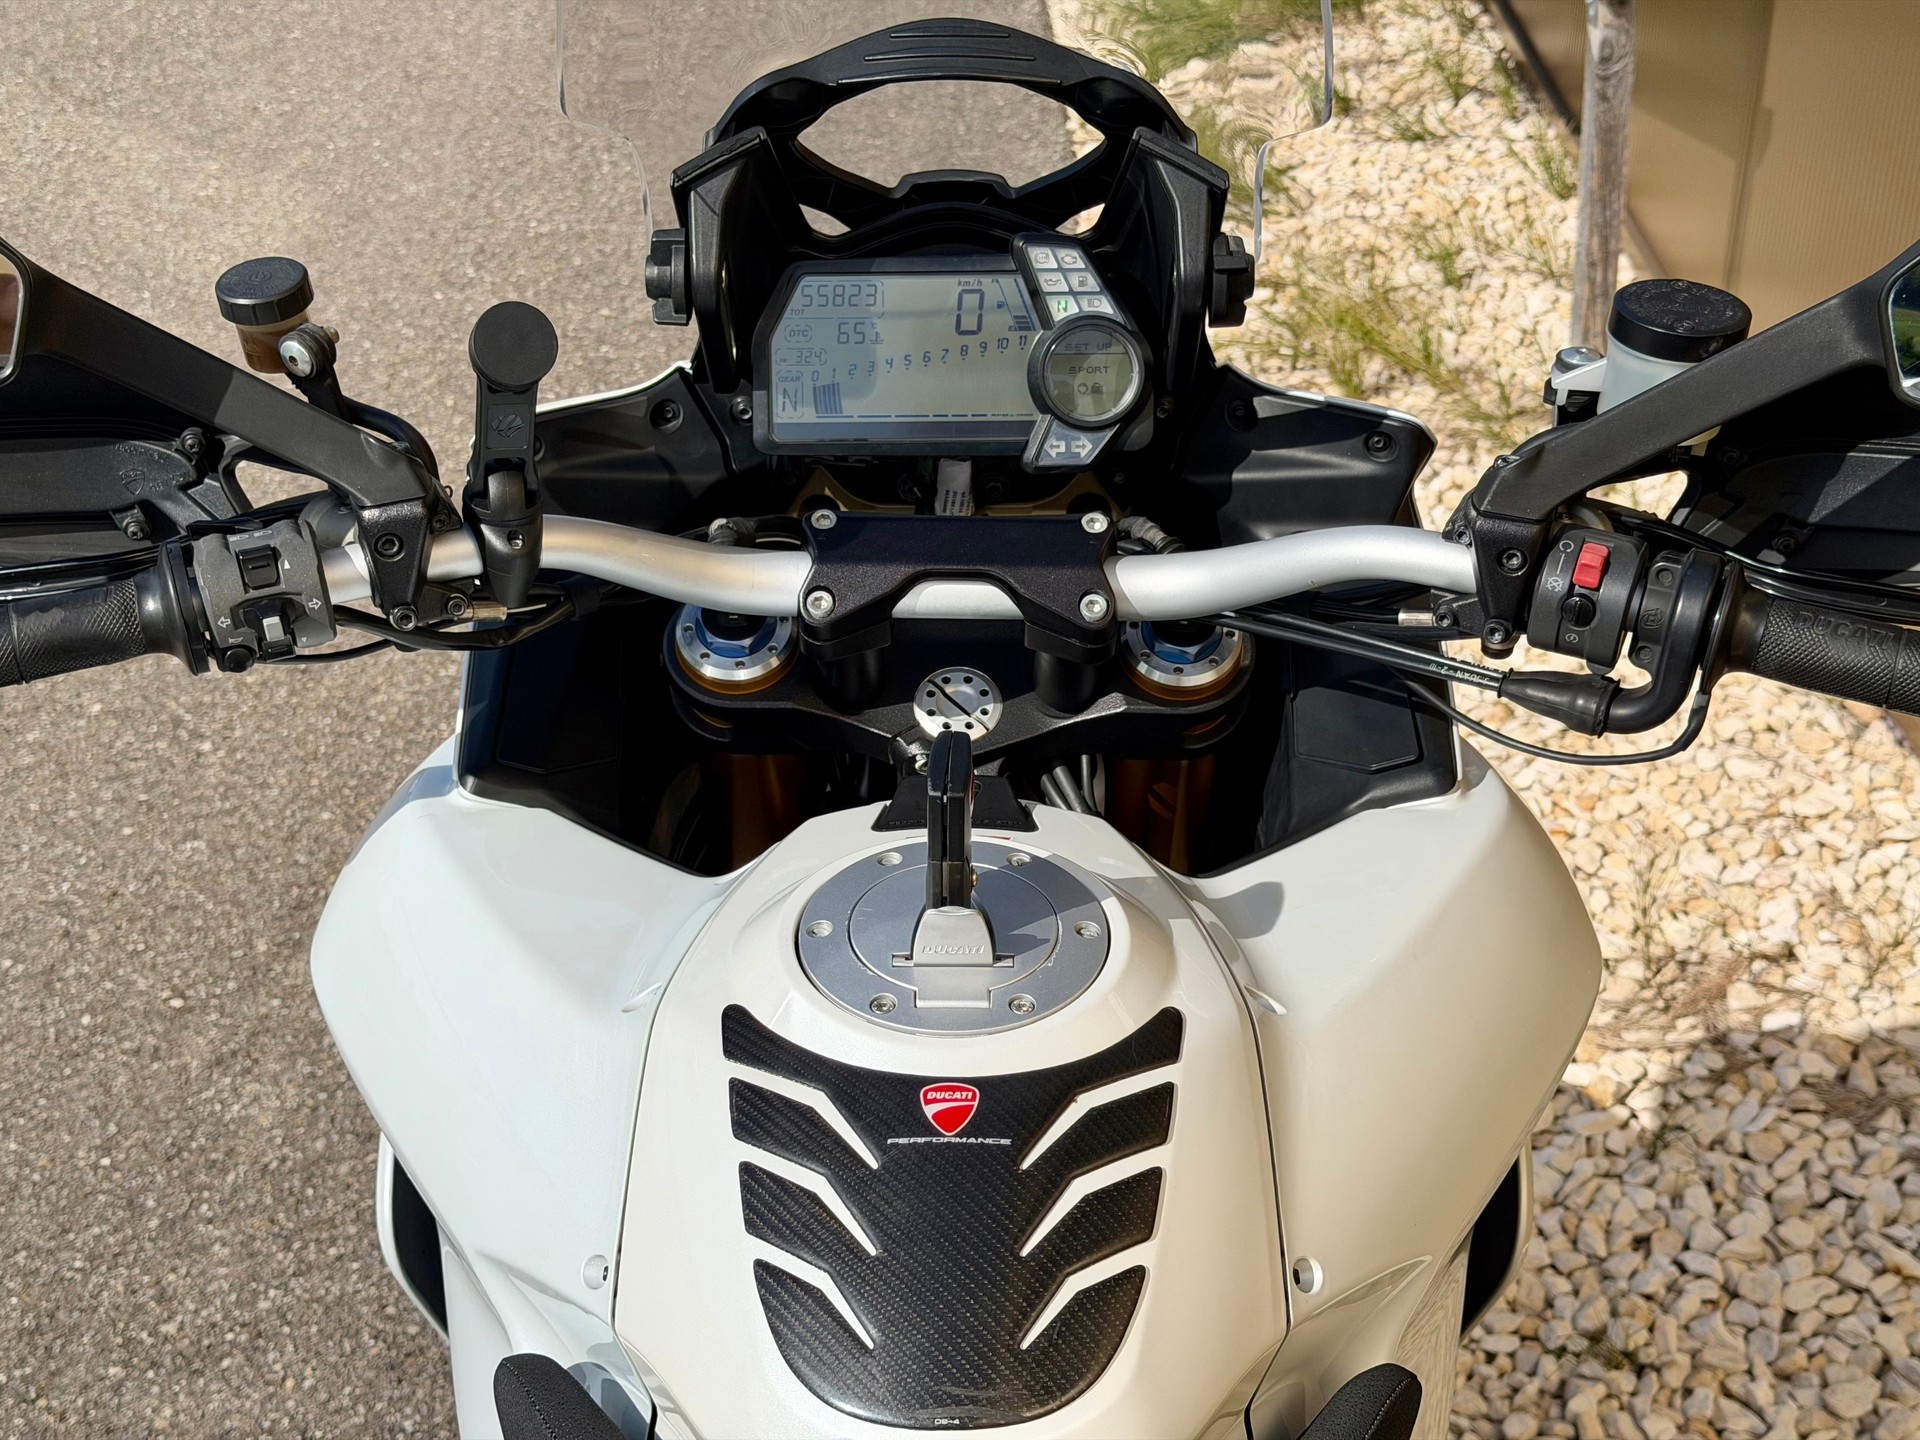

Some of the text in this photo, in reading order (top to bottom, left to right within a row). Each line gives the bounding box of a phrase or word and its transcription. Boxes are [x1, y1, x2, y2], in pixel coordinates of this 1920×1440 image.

[957, 279, 983, 287] km/h
[800, 284, 878, 307] 55823
[1056, 299, 1068, 314] N
[790, 308, 805, 316] TOT
[955, 288, 985, 336] 0
[788, 328, 810, 338] DTC
[836, 322, 866, 345] 65
[1064, 343, 1113, 352] SET UP
[795, 350, 823, 364] 324
[848, 363, 857, 376] 2
[866, 360, 875, 373] 3
[885, 357, 894, 369] 4
[903, 354, 912, 367] 5
[922, 350, 931, 363] 6
[940, 348, 950, 361] 7
[959, 344, 969, 357] 8
[979, 341, 988, 354] 9
[996, 337, 1009, 350] 10
[1018, 334, 1028, 347] 11
[1068, 366, 1110, 375] SPORT
[778, 375, 801, 383] GEAR
[781, 387, 798, 412] N
[1794, 611, 1895, 650] DUCATI
[922, 945, 985, 954] DUCATI
[926, 1091, 973, 1100] DUCATI
[886, 1136, 1013, 1145] PERFORMANCE
